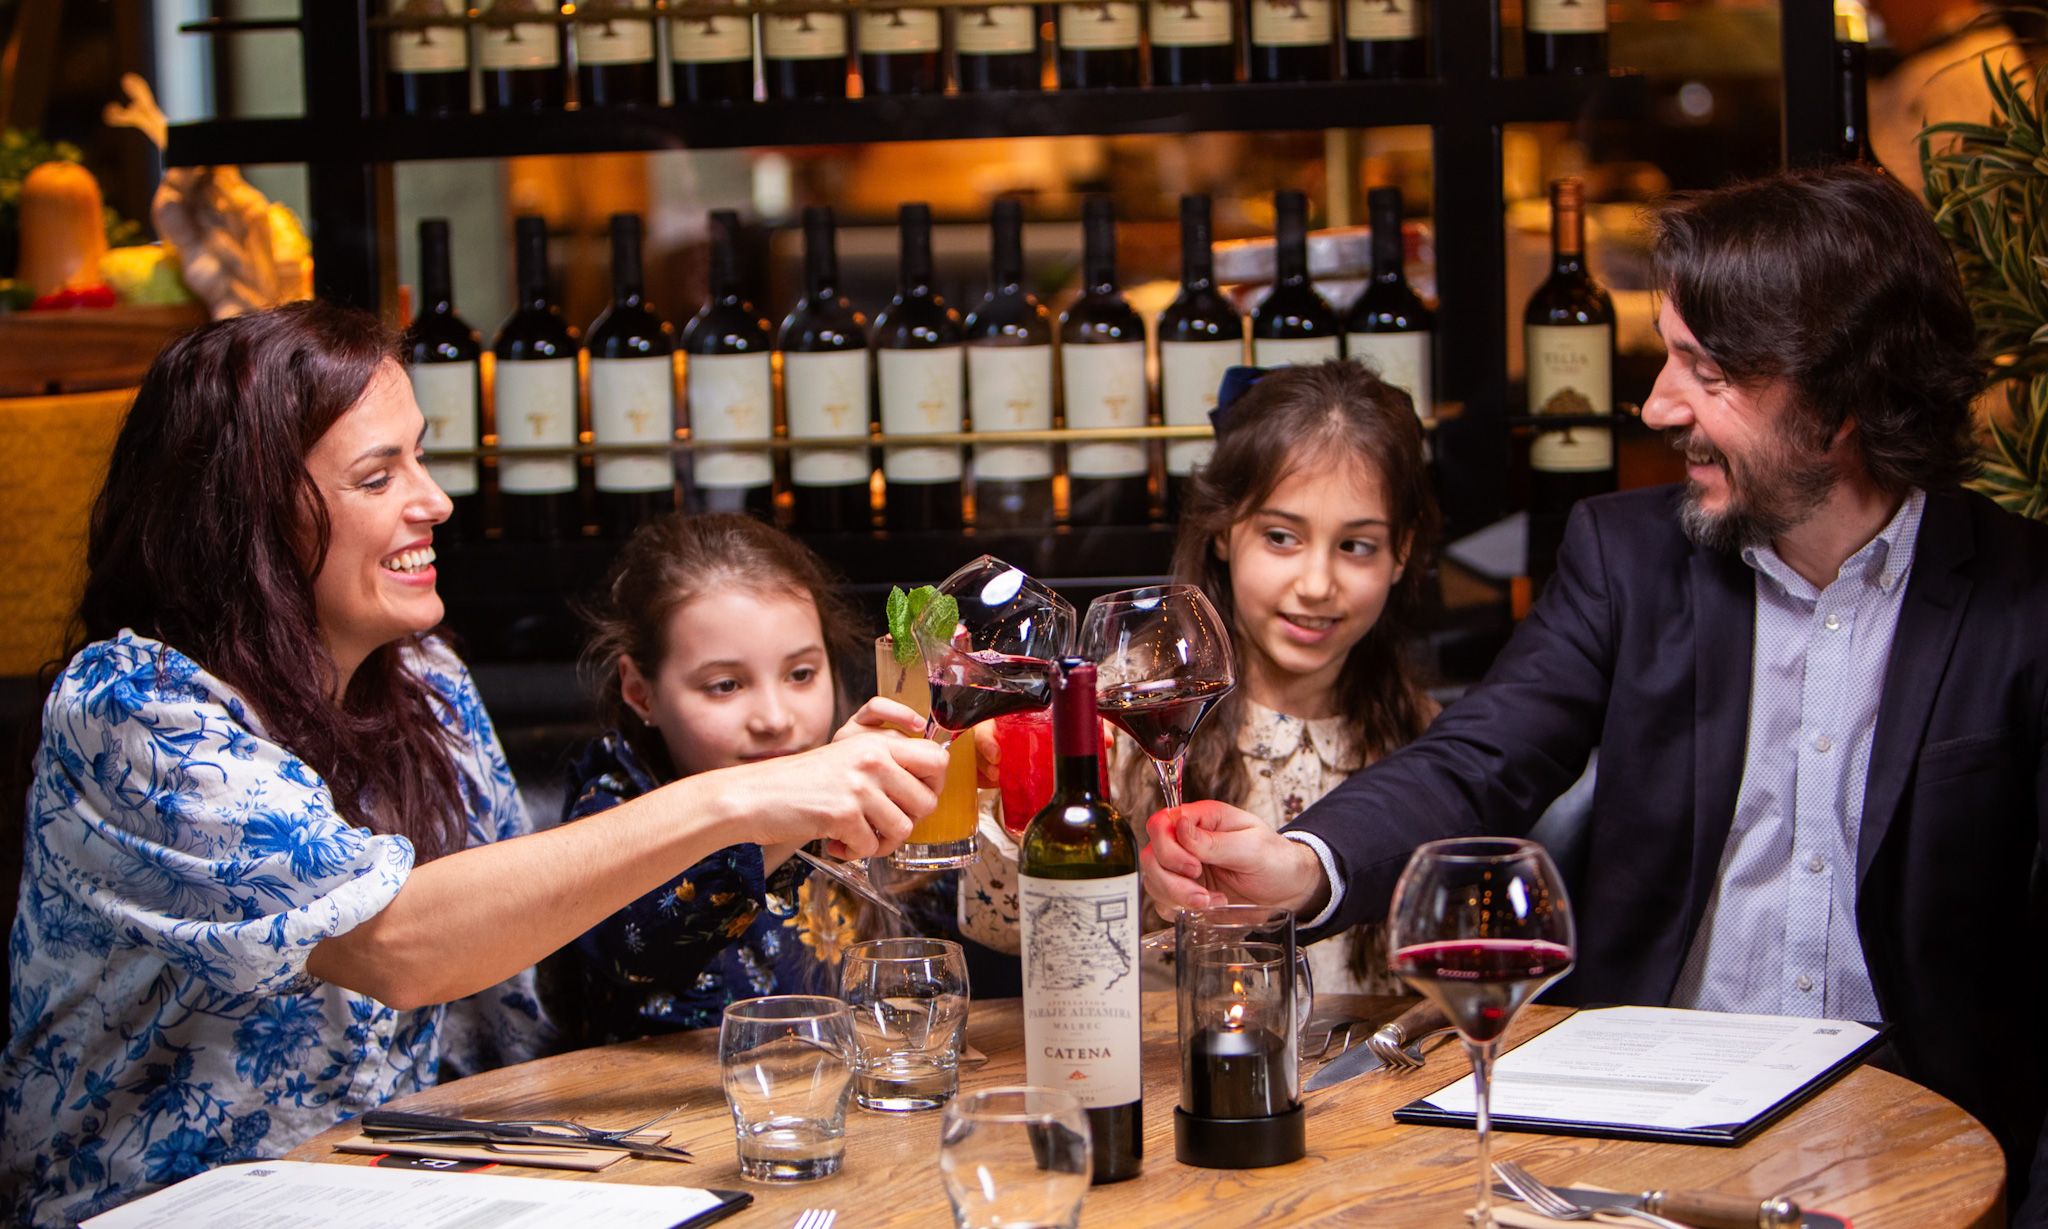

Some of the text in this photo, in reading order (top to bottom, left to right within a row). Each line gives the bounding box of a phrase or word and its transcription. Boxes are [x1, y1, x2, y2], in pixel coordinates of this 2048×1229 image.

[1028, 1007, 1132, 1019] PARAJE ALTAMIRA
[1053, 1022, 1102, 1031] MALBEC
[1044, 1046, 1112, 1060] CATENA
